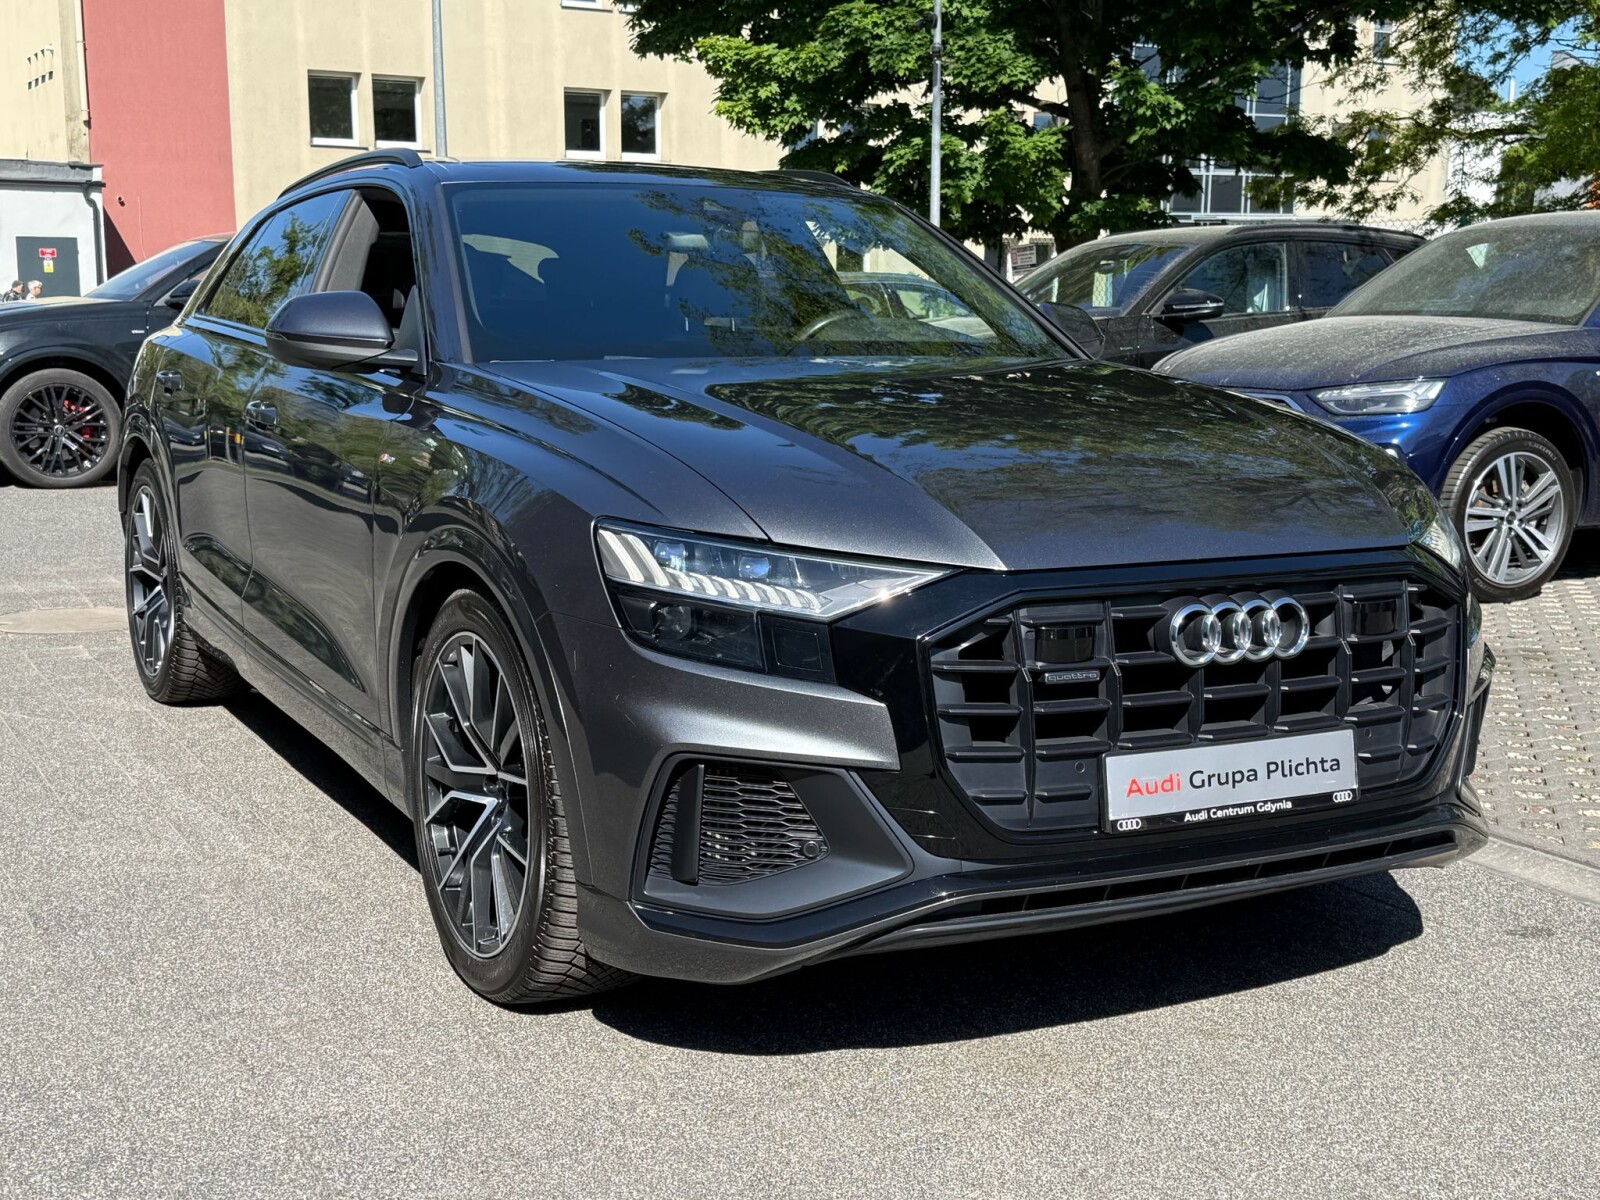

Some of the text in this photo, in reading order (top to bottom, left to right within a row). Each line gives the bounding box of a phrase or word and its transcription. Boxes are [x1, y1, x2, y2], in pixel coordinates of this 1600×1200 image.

[1048, 673, 1097, 681] quattro
[1126, 757, 1341, 798] Audi Grupa Plichta
[1184, 800, 1293, 822] Audi Centrum Gdynia
